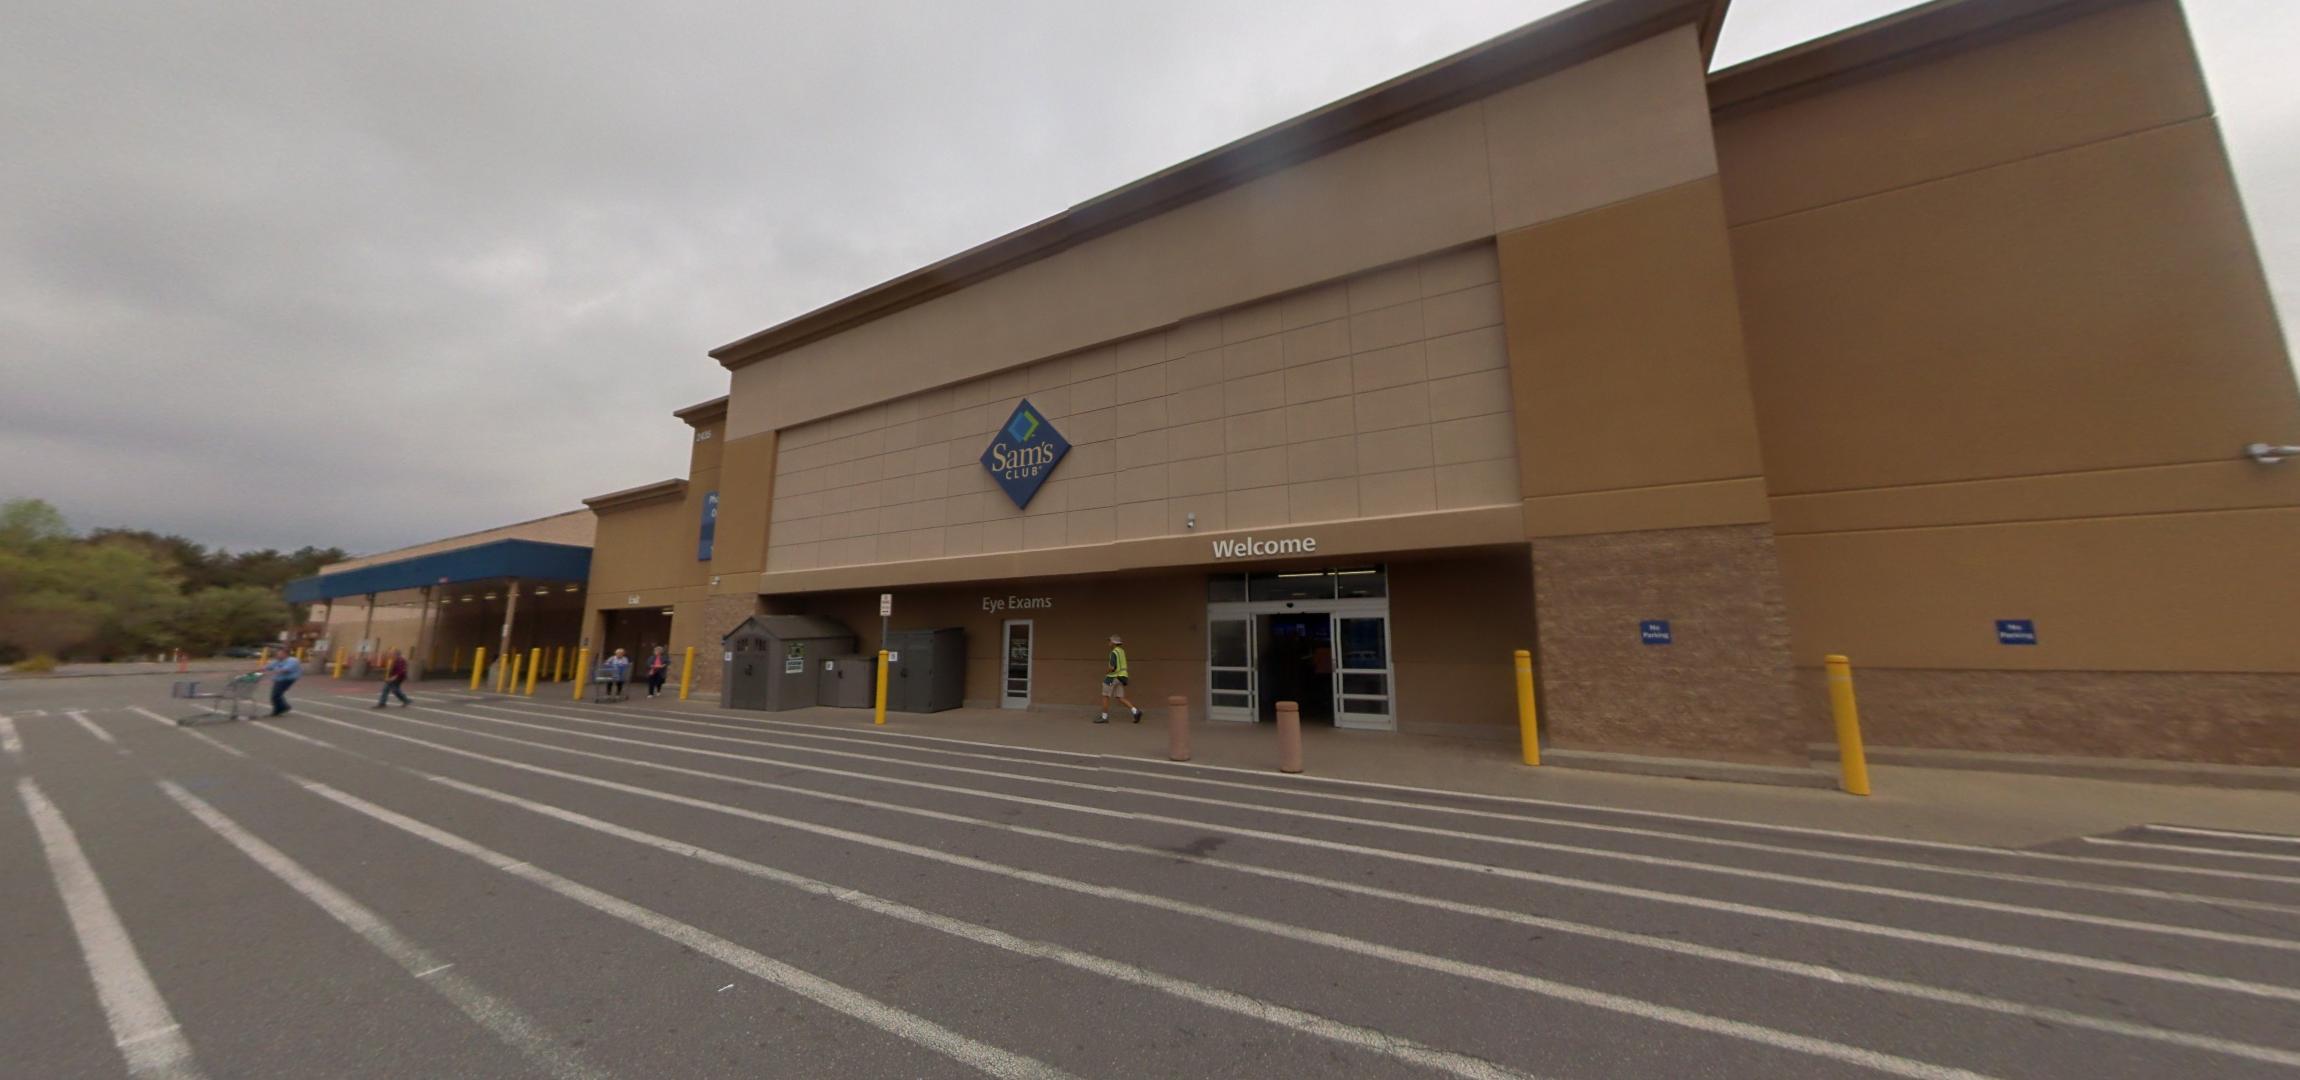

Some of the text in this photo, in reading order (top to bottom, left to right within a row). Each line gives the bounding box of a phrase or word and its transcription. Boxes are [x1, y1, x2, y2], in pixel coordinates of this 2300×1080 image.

[992, 441, 1054, 472] Sam's
[1005, 466, 1039, 480] CLUB
[1212, 536, 1317, 558] Welcome
[982, 595, 1053, 613] Eye Exams
[1649, 623, 1661, 631] No
